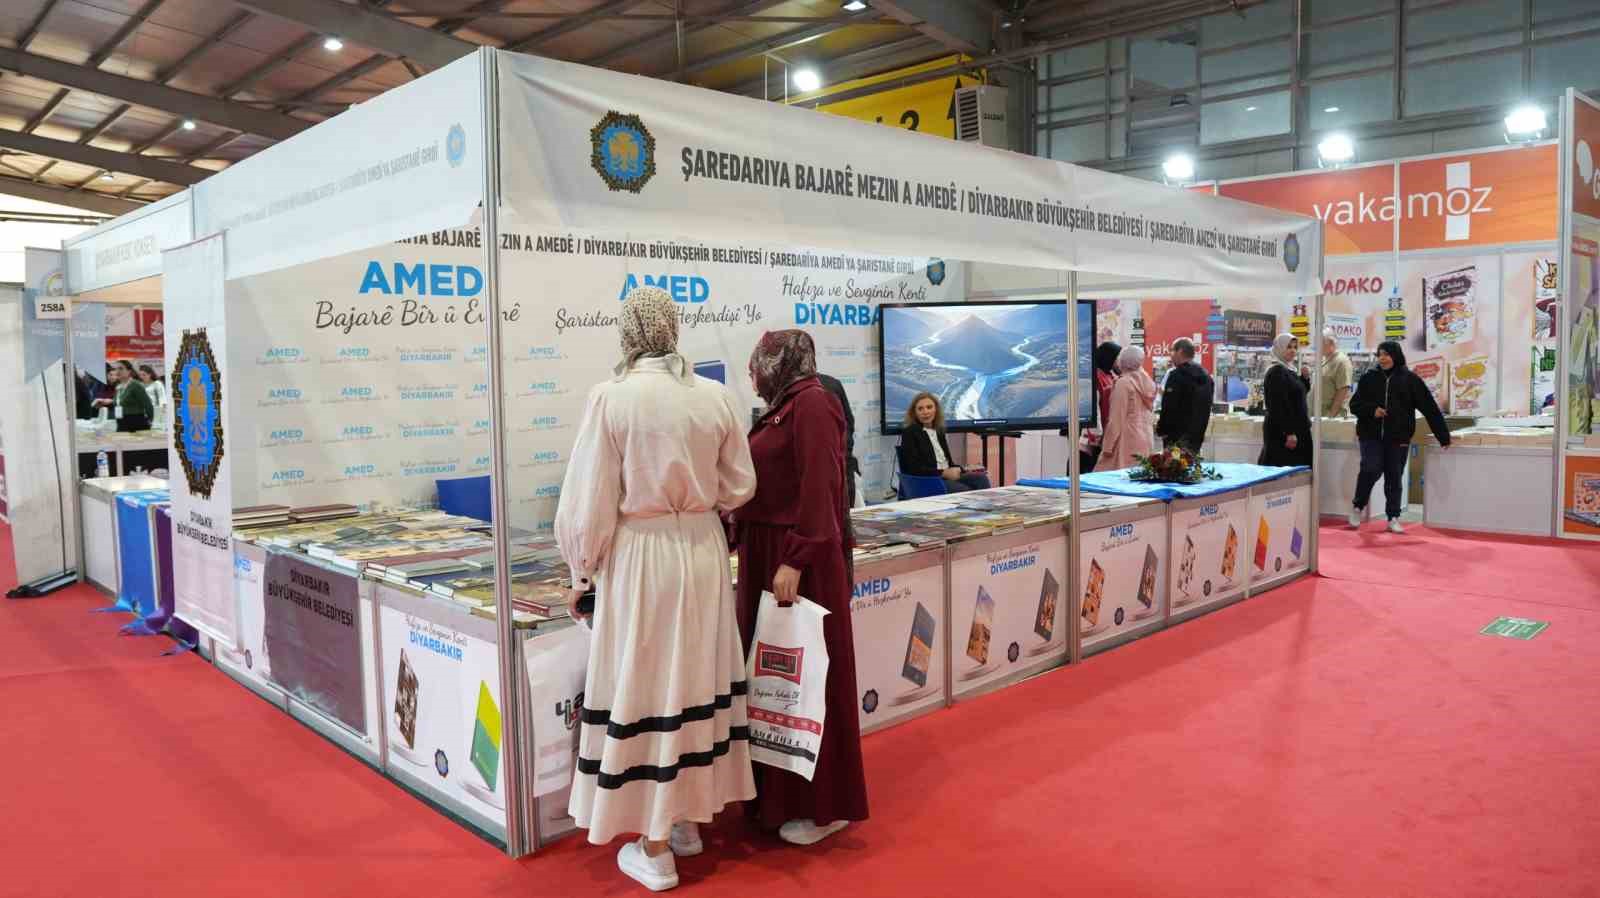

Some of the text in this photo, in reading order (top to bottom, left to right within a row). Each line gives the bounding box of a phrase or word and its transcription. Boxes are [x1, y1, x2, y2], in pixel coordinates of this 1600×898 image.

[681, 146, 791, 189] ŞAREDARIYA
[795, 164, 853, 197] BAJARÊ
[857, 173, 899, 203] MEZIN
[902, 181, 912, 205] A
[915, 181, 957, 211] AMEDÊ
[968, 186, 1034, 223] DİYARBAKIR
[1036, 198, 1096, 232] BÜYÜKŞEHİR
[1097, 210, 1143, 238] BELEDİYESİ
[432, 226, 480, 248] BAJARÊ
[500, 233, 521, 250] ZIN
[524, 235, 533, 251] A
[536, 233, 574, 254] AMEDÊ
[584, 236, 647, 258] DİYARBAKIR
[650, 240, 710, 263] BÜYÜKŞEHİR
[712, 246, 762, 265] BELEDİYESİ
[845, 257, 856, 271] YA
[359, 260, 484, 297] AMED
[620, 273, 710, 303] AMED
[828, 286, 841, 297] ve
[845, 278, 894, 303] Sevginin
[898, 281, 927, 300] Kenti
[1323, 276, 1383, 295] ADAKO
[41, 303, 65, 313] 258A
[315, 300, 394, 335] Bajarê
[401, 298, 438, 327] Bîr
[444, 305, 457, 324] û
[555, 308, 619, 335] Şaristan
[744, 304, 762, 323] Yo
[794, 302, 880, 326] DİYARBA
[1110, 523, 1133, 538] AMED
[851, 578, 890, 597] AMED
